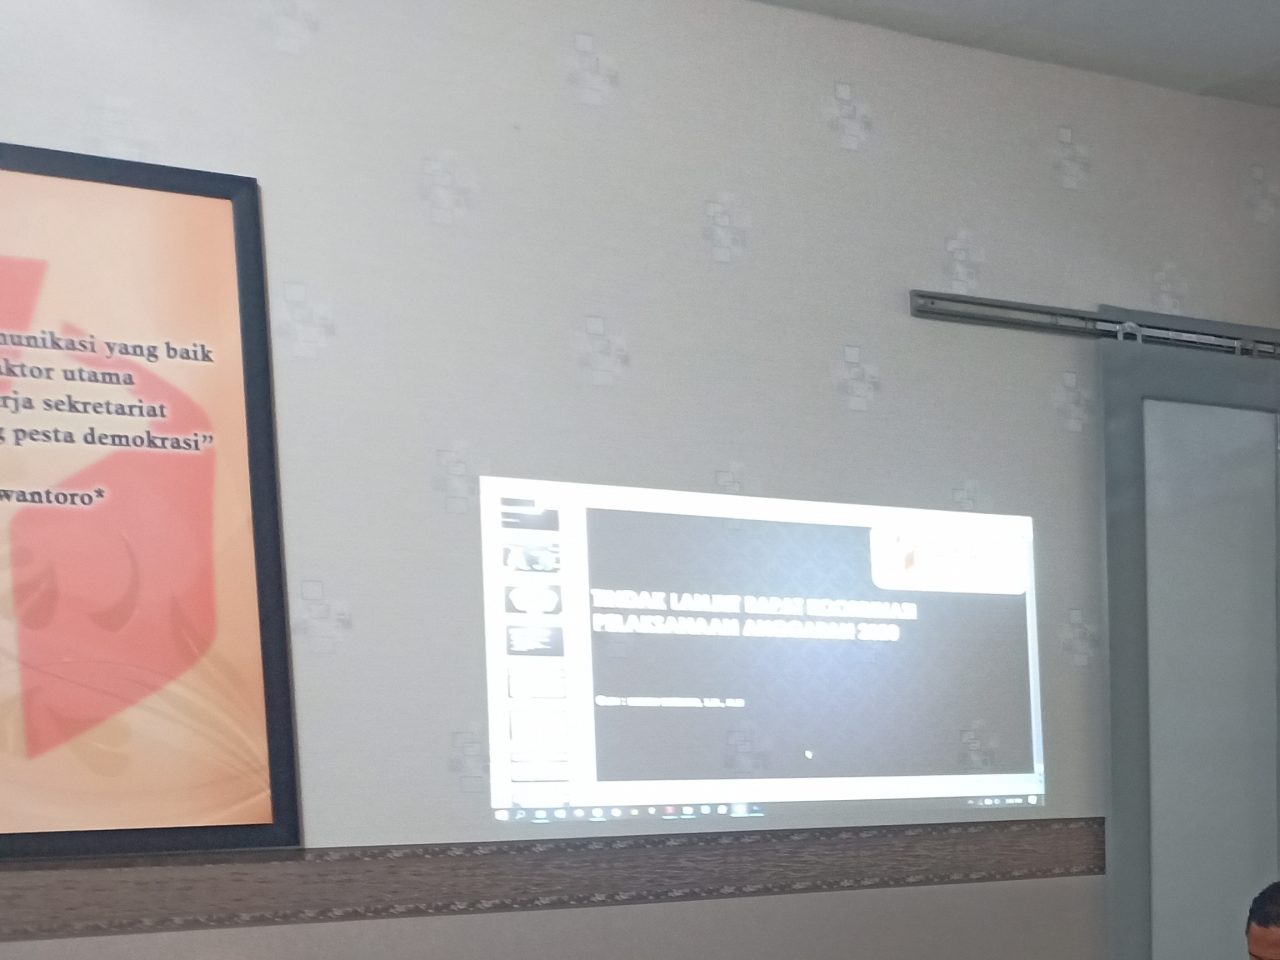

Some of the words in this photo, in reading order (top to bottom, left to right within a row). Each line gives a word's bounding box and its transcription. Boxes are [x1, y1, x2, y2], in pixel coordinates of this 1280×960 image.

[104, 340, 159, 362] yang
[165, 342, 214, 363] baik
[62, 366, 135, 386] utama
[43, 395, 167, 418] sekretariat
[13, 427, 75, 446] pesta
